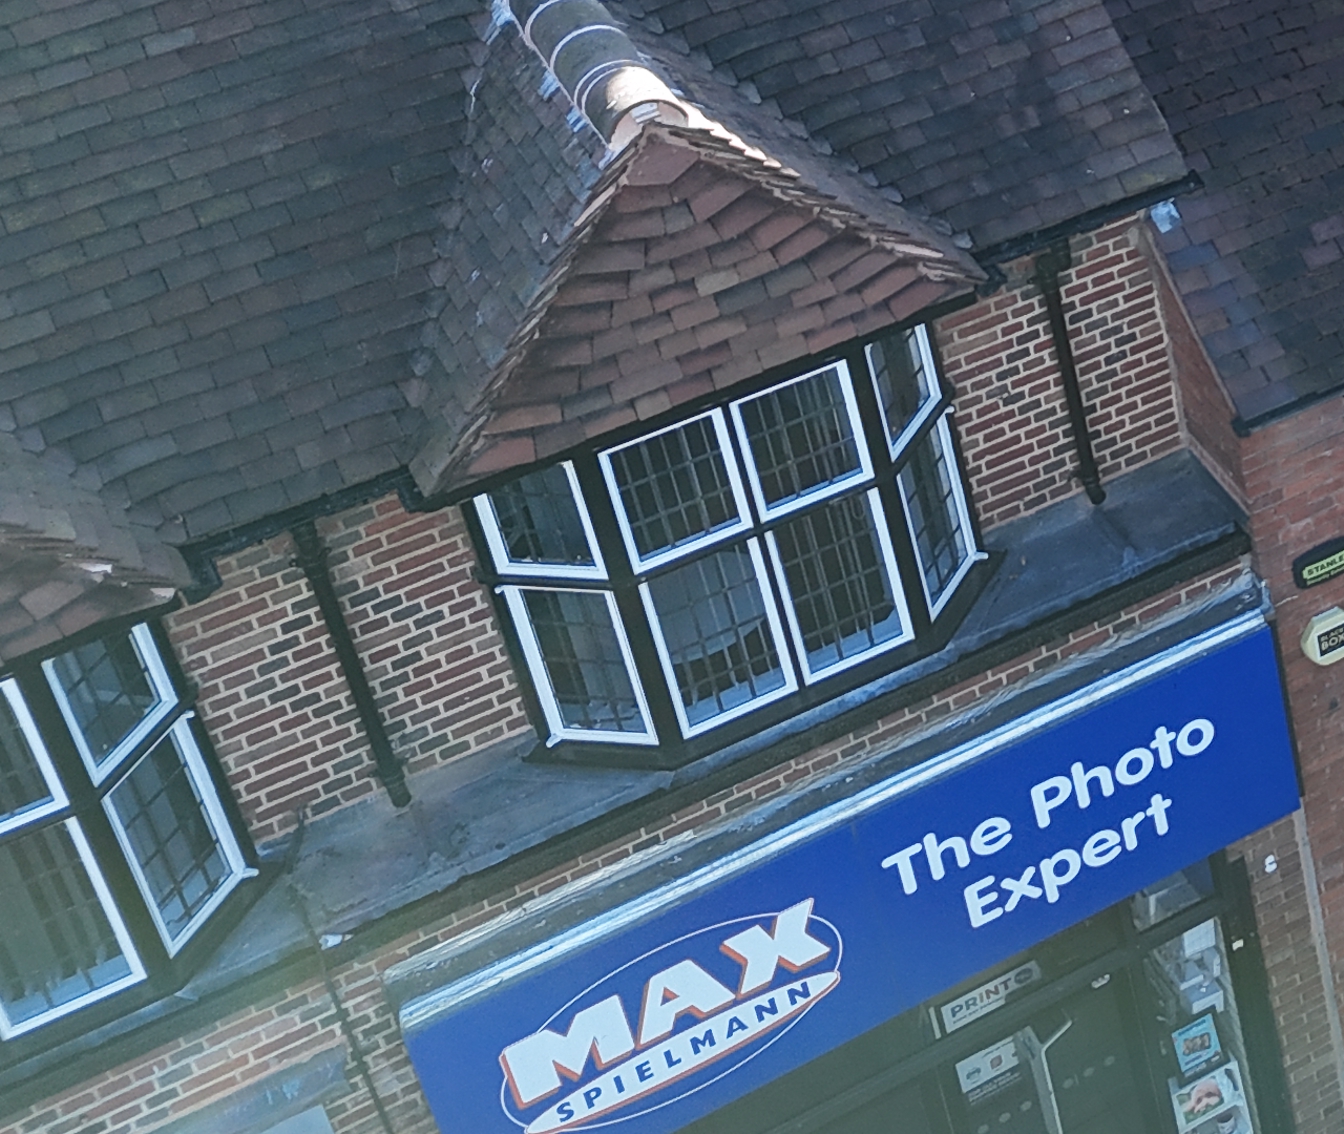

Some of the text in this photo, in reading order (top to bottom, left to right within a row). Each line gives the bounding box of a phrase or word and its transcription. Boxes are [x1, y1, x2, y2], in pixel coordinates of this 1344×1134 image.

[881, 718, 1215, 895] The Photo
[963, 793, 1173, 928] Expert
[499, 897, 831, 1109] MAX
[556, 981, 812, 1123] SPIELMANN
